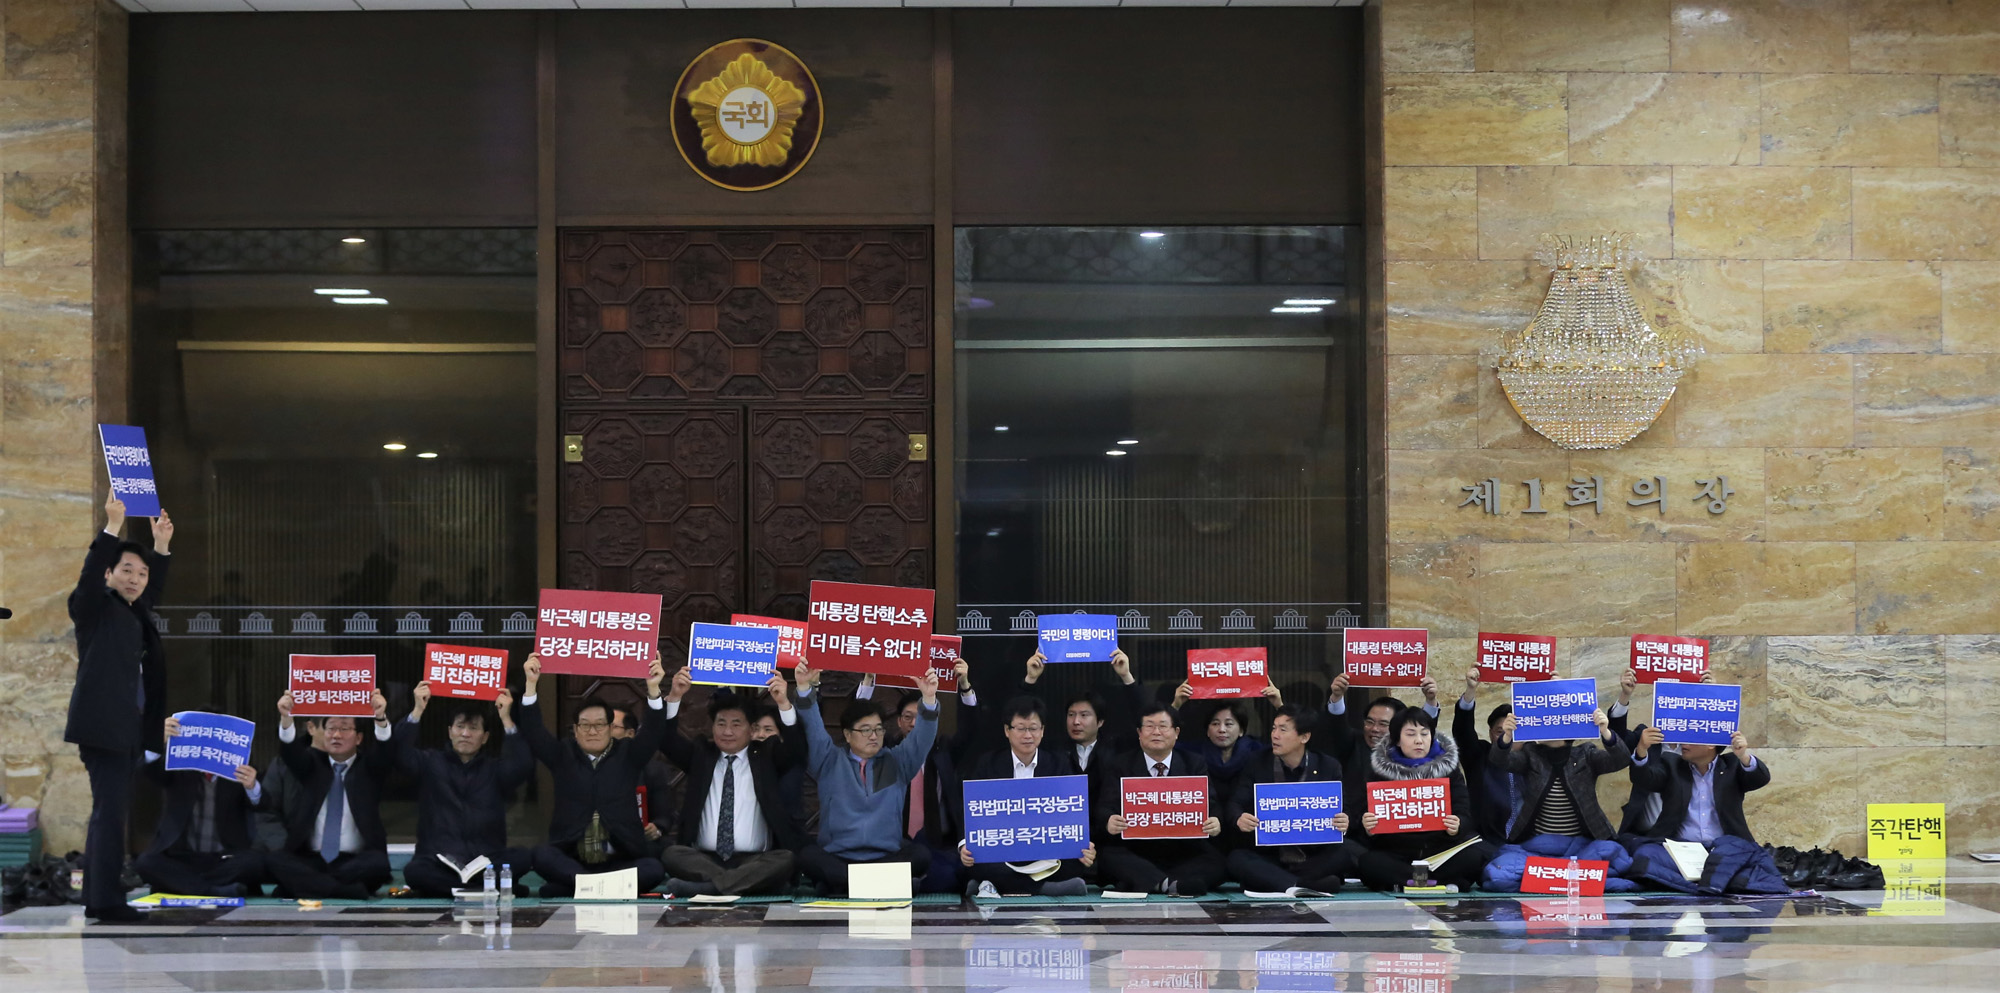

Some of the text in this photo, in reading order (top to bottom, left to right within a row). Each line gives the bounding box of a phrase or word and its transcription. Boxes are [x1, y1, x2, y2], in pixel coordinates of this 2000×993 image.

[722, 101, 769, 129] 국회
[540, 608, 653, 631] 박근혜 대통령은
[811, 601, 928, 628] 대통령 탄핵소추
[1041, 628, 1115, 641] 국민의 명령이다!
[540, 637, 649, 661] 당장 퇴진하라!
[695, 636, 775, 654] 헌법파괴 국정농단
[810, 633, 922, 660] 더 미룰 수 없다!
[1348, 642, 1425, 655] 대통령 탄핵소추
[1482, 640, 1551, 655] 박근혜 대통령
[1636, 642, 1704, 658] 박근혜 대통령
[431, 651, 502, 670] 박근혜 대통령
[692, 658, 772, 675] 대통령 즉각 탄핵!
[1192, 660, 1264, 678] 박근혜 탄핵
[1482, 654, 1550, 673] 퇴진하라!
[1636, 656, 1704, 674] 퇴진하라!
[293, 669, 372, 683] 박근혜 대통령은
[430, 666, 501, 688] 퇴진하라!
[1348, 662, 1422, 677] 더 미룰 수 없다!
[292, 690, 370, 704] 당장 퇴진하라!
[1514, 692, 1595, 709] 국민의 명령이다!
[1657, 696, 1738, 712] 헌법파괴 국정농단
[1543, 714, 1561, 726] 당장
[1656, 718, 1735, 734] 대통령 즉각 탄핵!
[213, 728, 249, 747] 국정농단
[170, 745, 201, 758] 대통령
[202, 746, 222, 762] 즉각
[1126, 791, 1205, 805] 박근혜 대통령은
[1372, 786, 1444, 802] 박근혜 대통령
[968, 795, 1085, 817] 헌법파괴 국정농단
[1259, 796, 1340, 811] 헌법파괴 국정농단
[1374, 800, 1446, 820] 퇴진하라!
[1126, 812, 1203, 827] 당장 퇴진하라!
[1260, 819, 1290, 833] 대통령
[1292, 818, 1314, 832] 즉각
[970, 825, 1084, 847] 대통령 즉각 탄핵!
[1870, 818, 1941, 840] 즉각탄핵
[1528, 866, 1569, 880] 박근혜
